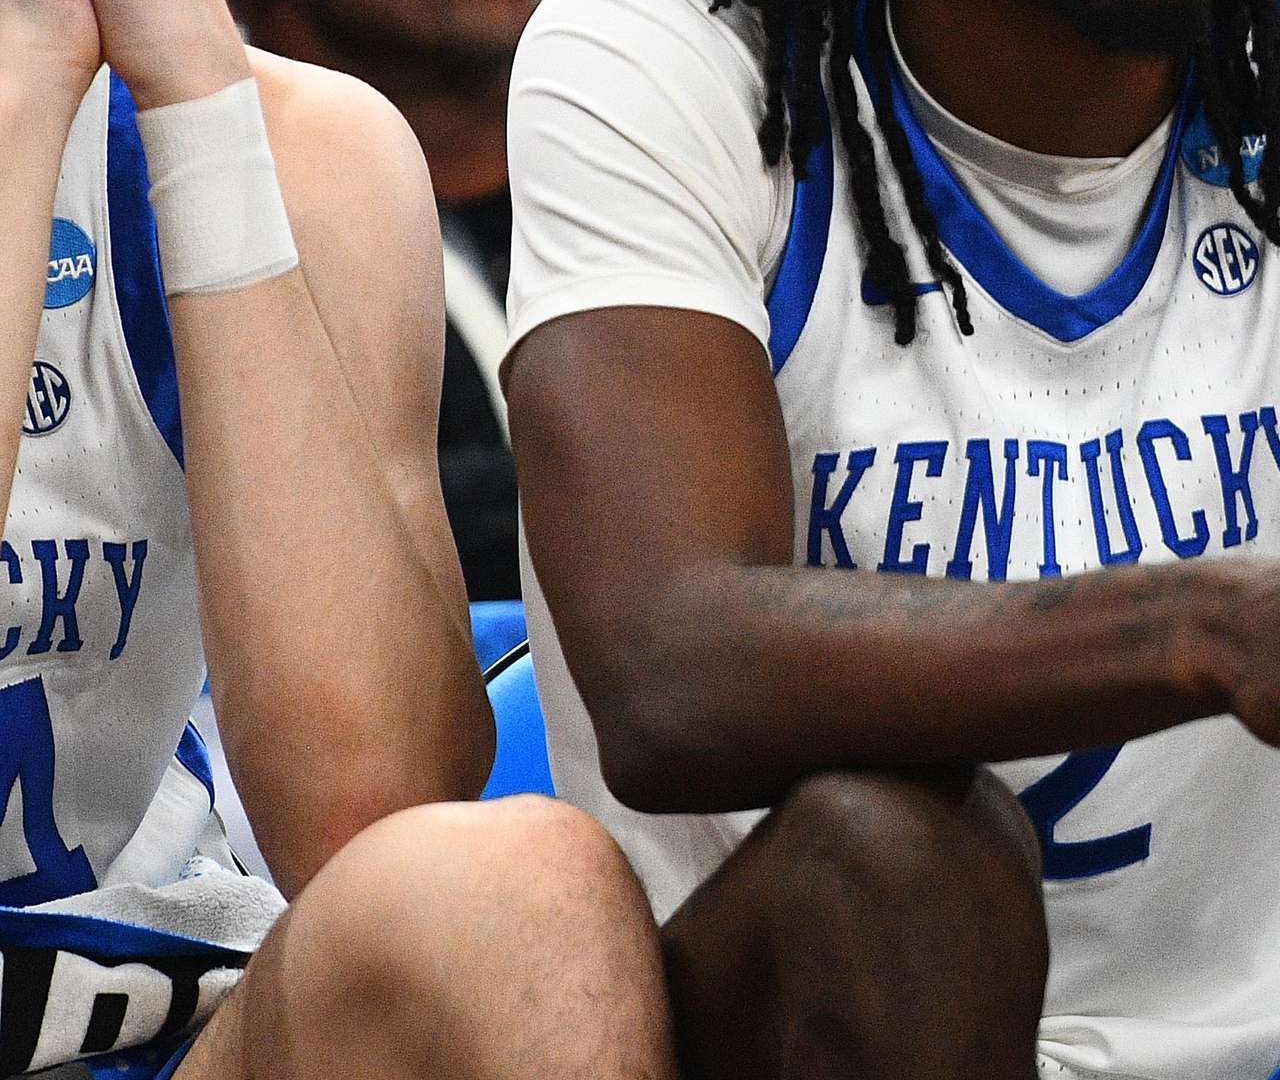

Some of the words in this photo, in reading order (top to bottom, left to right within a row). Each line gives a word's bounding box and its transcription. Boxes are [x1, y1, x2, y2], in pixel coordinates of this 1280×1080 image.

[47, 253, 94, 282] CAA
[1195, 227, 1256, 293] SEC
[23, 366, 67, 429] EC
